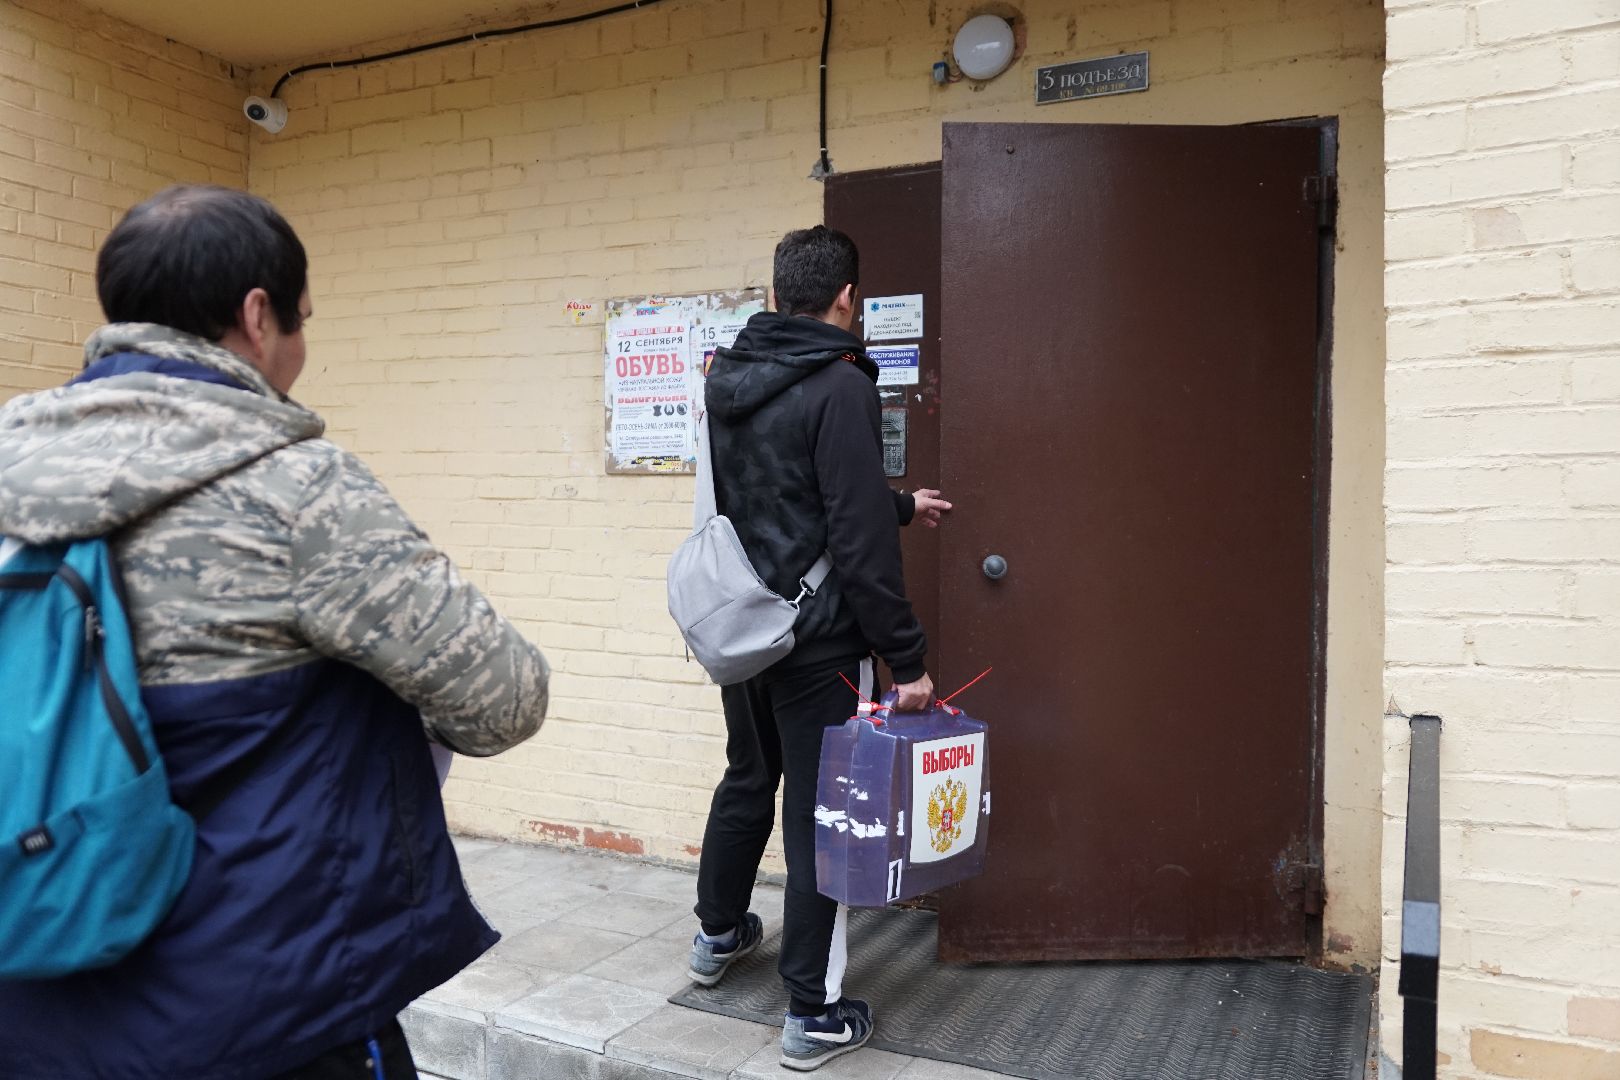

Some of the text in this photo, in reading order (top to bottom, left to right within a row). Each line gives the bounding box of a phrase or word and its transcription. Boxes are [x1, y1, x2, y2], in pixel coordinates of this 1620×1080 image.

[1041, 70, 1055, 90] 3
[1060, 64, 1142, 88] ПОДЪЕЗД
[701, 327, 716, 340] 15
[617, 341, 631, 353] 12
[635, 336, 683, 347] СЕНТЯБРЯ
[869, 351, 915, 359] ОБСЛУЖИВАНИЕ
[615, 352, 685, 378] ОБУВЬ
[922, 743, 975, 775] ВЫБОРЫ
